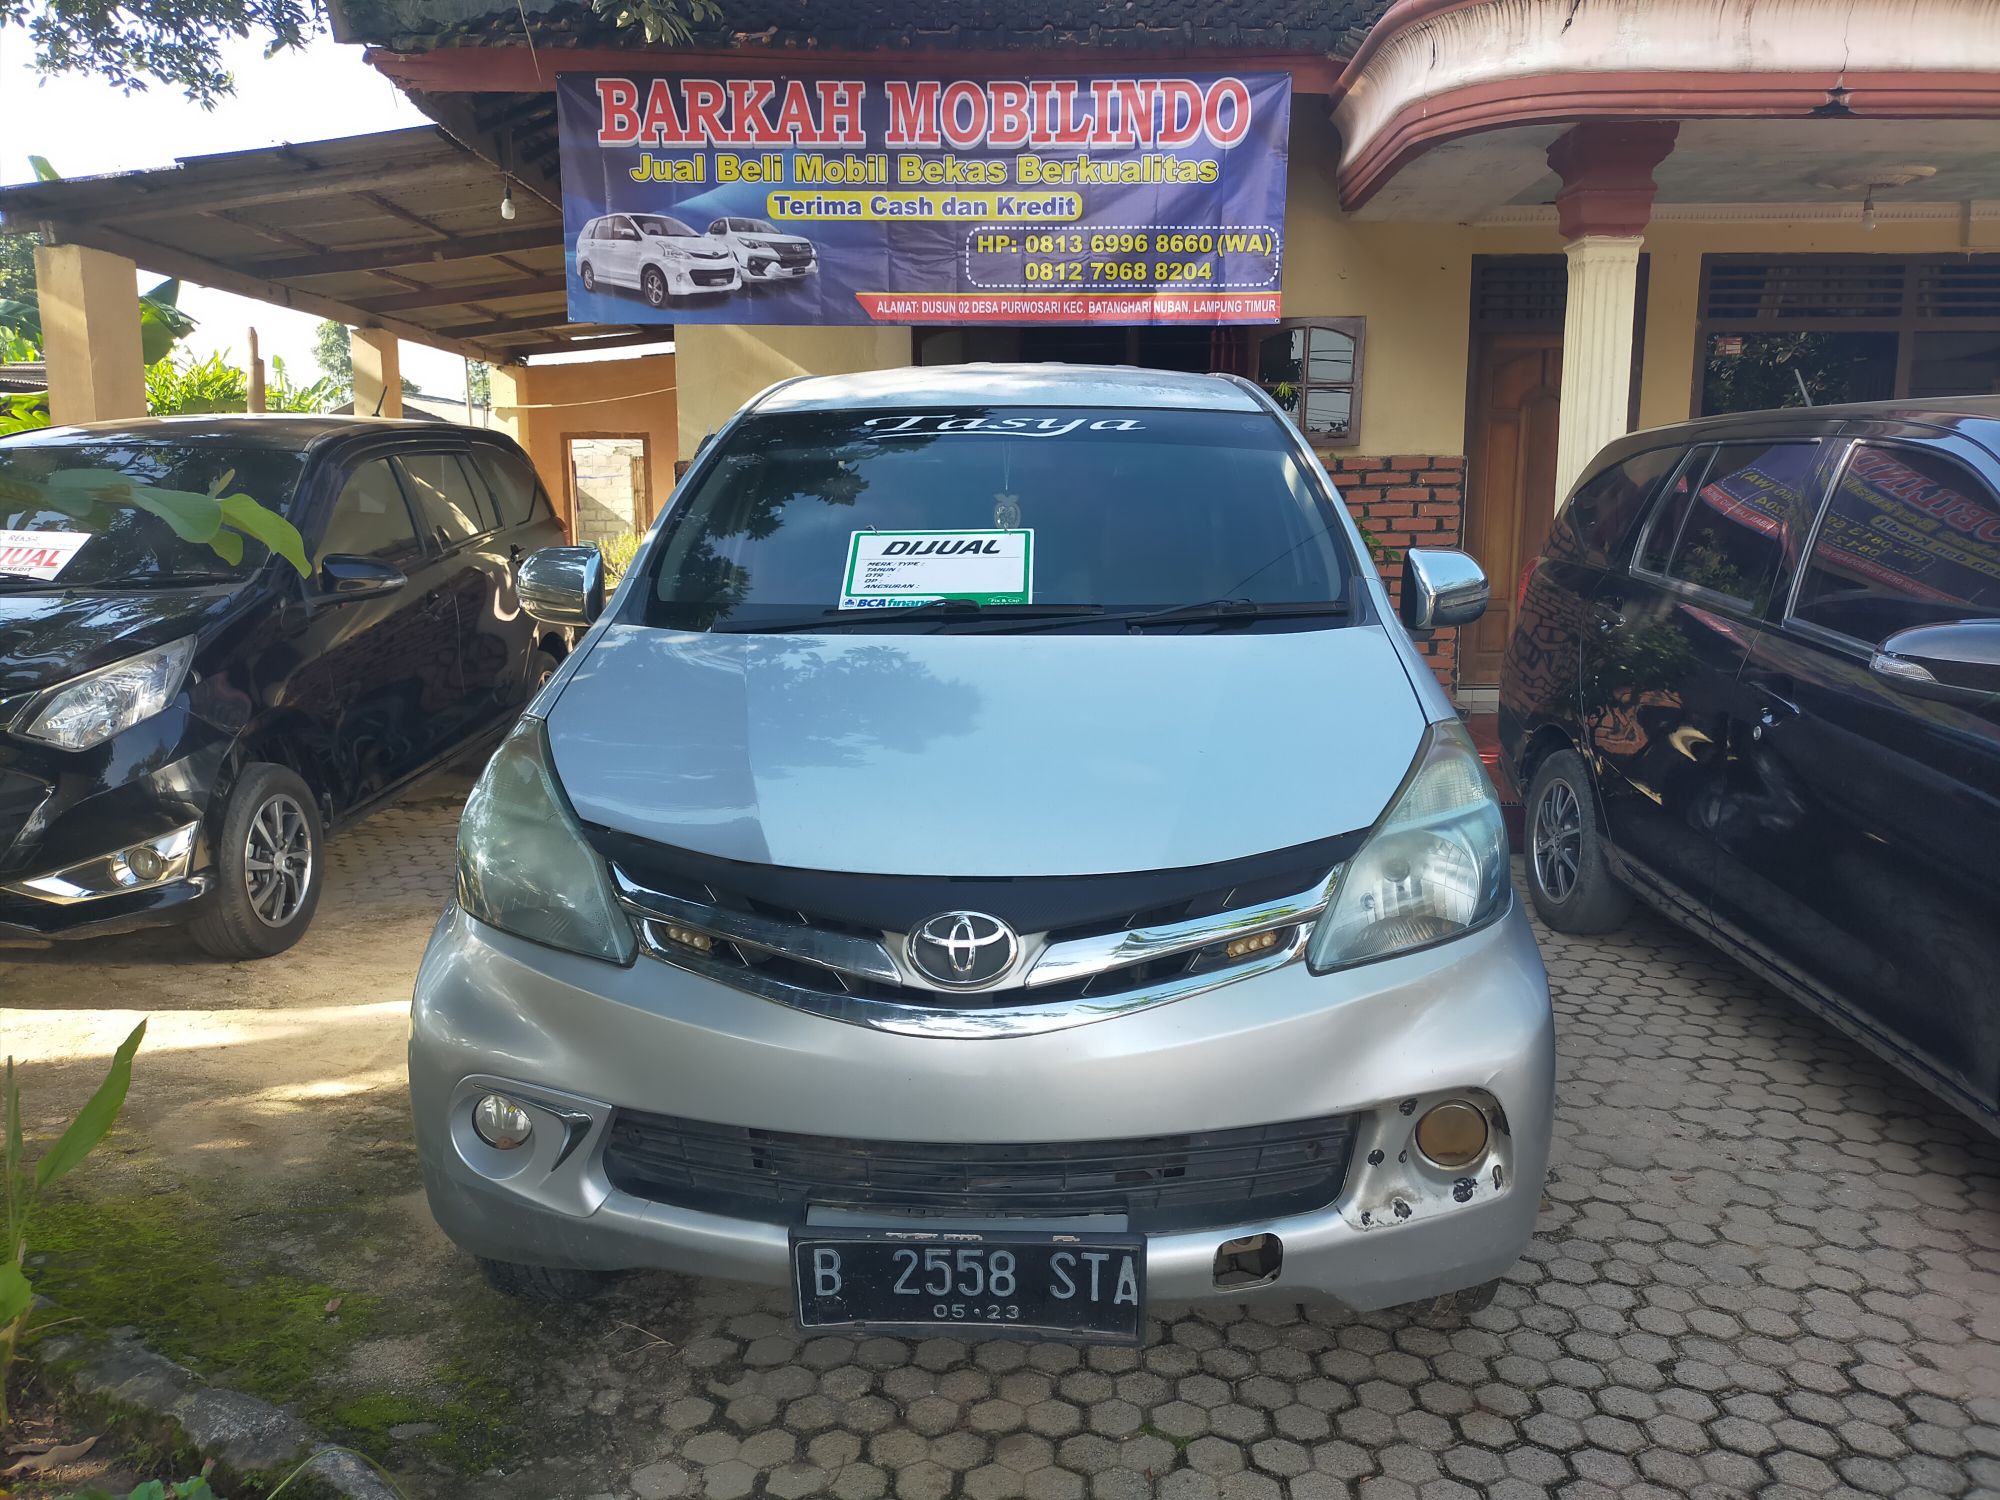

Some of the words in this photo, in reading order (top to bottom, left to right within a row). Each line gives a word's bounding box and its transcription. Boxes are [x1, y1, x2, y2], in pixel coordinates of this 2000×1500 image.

[596, 78, 866, 148] BARKAH
[885, 77, 1251, 149] MOBILINDO
[630, 153, 705, 182] Jual
[715, 153, 783, 182] Beli
[794, 153, 888, 183] Mobil
[898, 154, 1007, 183] Bekas
[1016, 154, 1218, 184] Berkualitas
[773, 195, 862, 216] Terima
[870, 195, 933, 216] Cash
[942, 196, 988, 216] dan
[996, 196, 1076, 217] Kredit
[977, 235, 1018, 253] HP:
[1025, 234, 1083, 253] 0813
[1091, 234, 1148, 253] 6996
[1155, 234, 1213, 253] 8660
[1217, 233, 1272, 257] (WA)
[1025, 262, 1083, 281] 0812
[1090, 262, 1147, 281] 7968
[1154, 262, 1212, 281] 8204
[877, 301, 919, 313] ALAMAT:
[921, 301, 956, 314] DUSUN
[958, 301, 970, 314] 02
[972, 301, 999, 314] DESA
[1001, 301, 1061, 314] PURWOSARI
[1063, 301, 1086, 314] KEC.
[1088, 301, 1151, 314] BATANGHARI
[1154, 300, 1191, 315] NUBAN,
[1193, 300, 1242, 313] LAMPUNG
[1244, 300, 1276, 313] TIMUR
[864, 414, 1147, 439] Tasya
[881, 540, 1001, 555] DIJUAL
[813, 1248, 841, 1296] B
[892, 1249, 1016, 1297] 2558
[1049, 1251, 1138, 1306] STA
